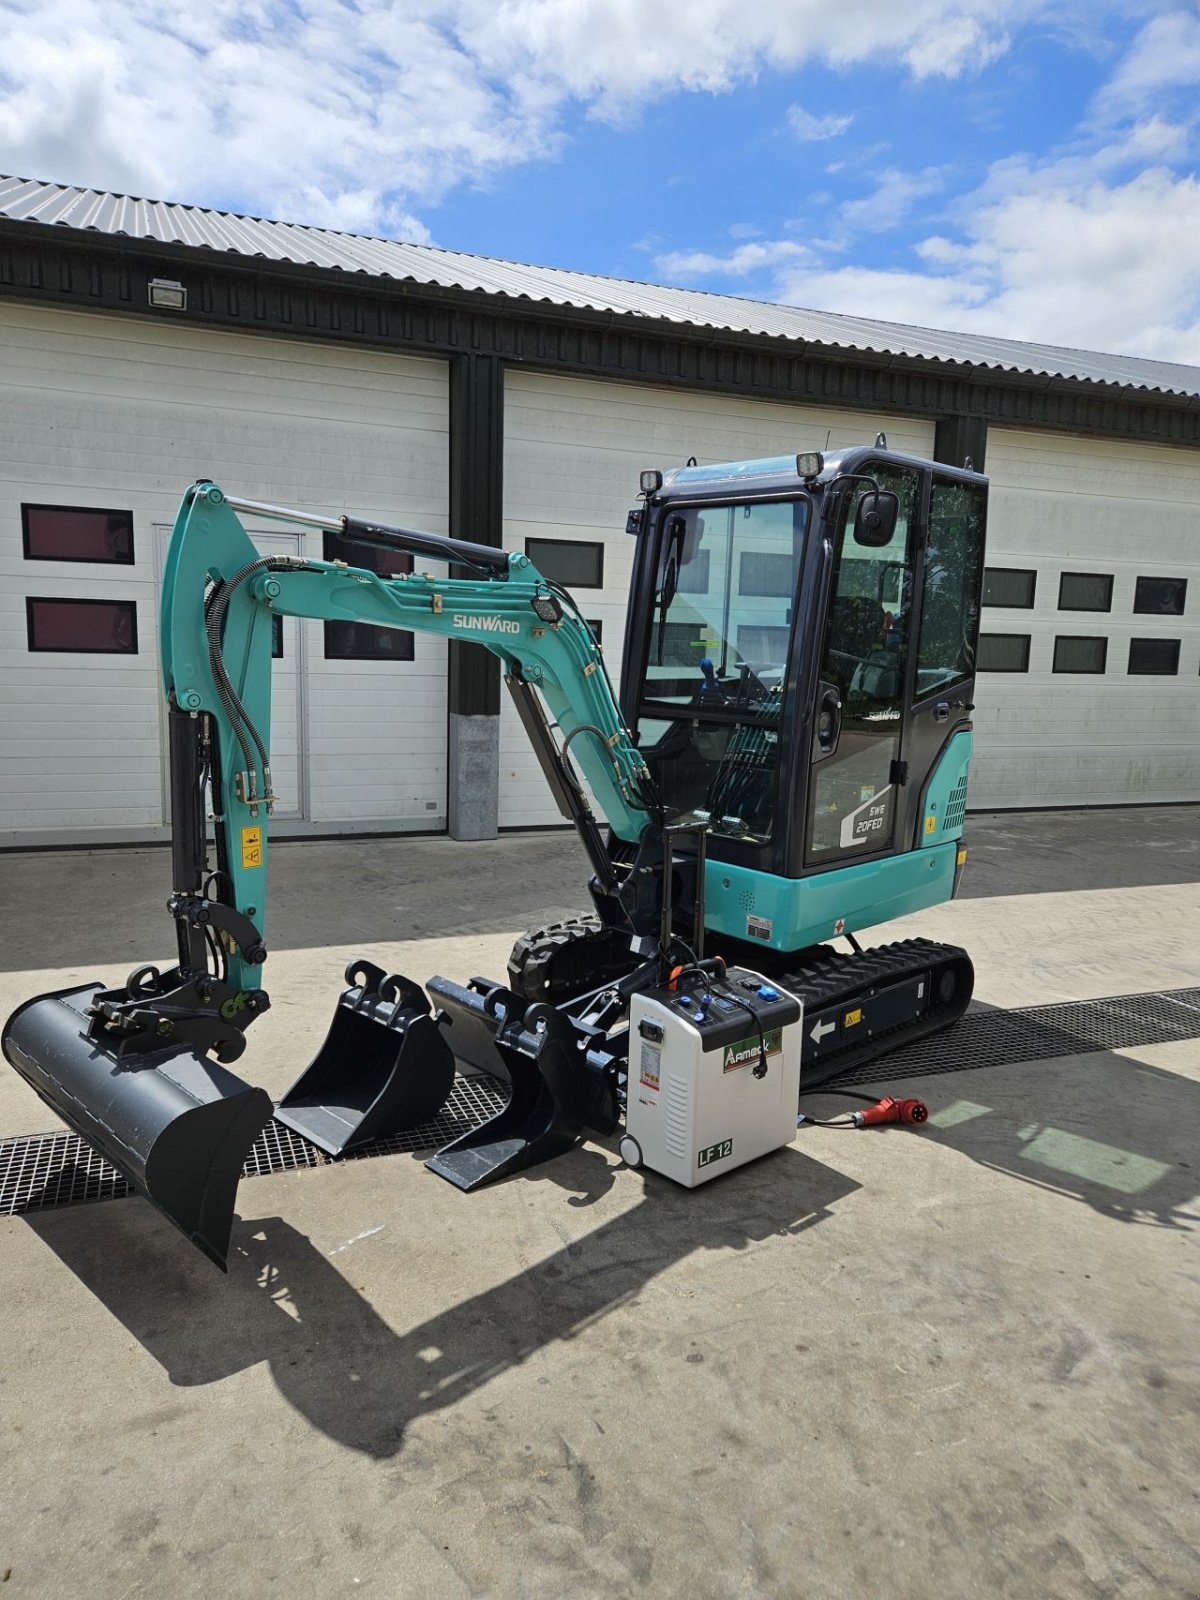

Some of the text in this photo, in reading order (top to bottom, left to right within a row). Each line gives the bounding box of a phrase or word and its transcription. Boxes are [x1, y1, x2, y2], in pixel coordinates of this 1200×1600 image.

[453, 614, 520, 634] SUNWARD
[699, 1141, 731, 1165] LF 12
